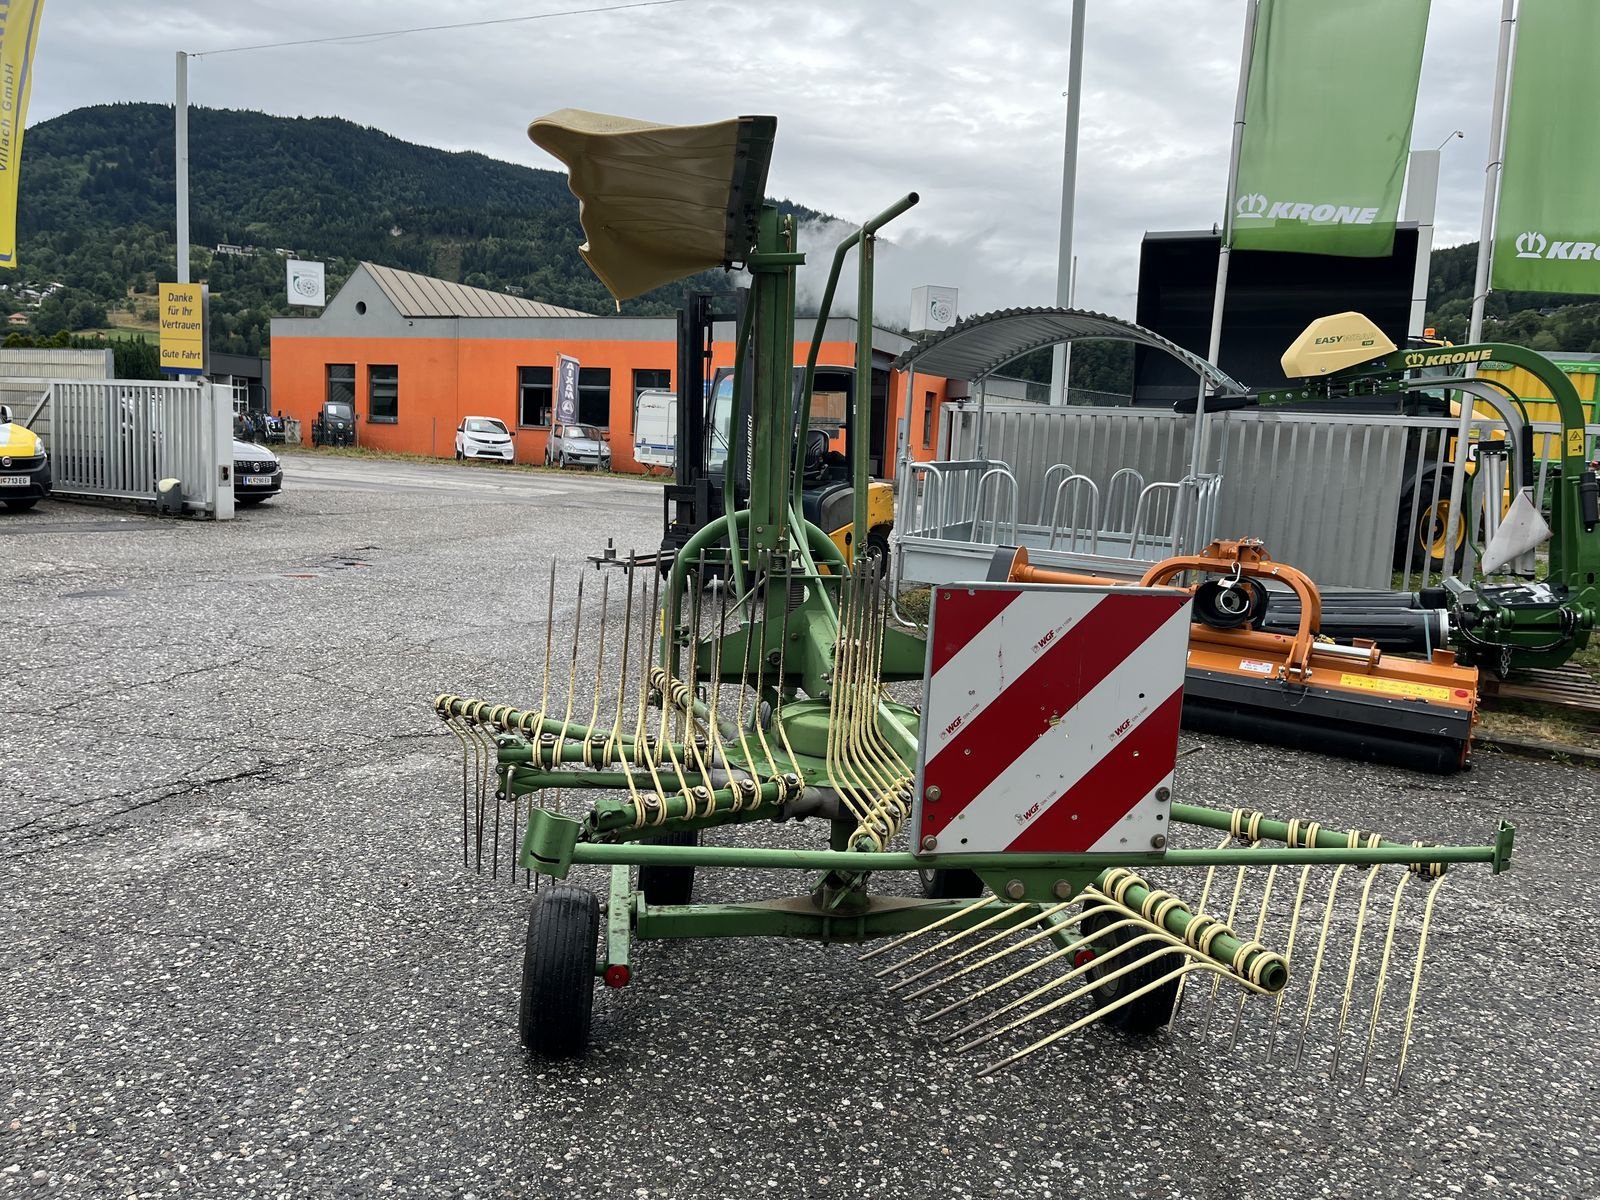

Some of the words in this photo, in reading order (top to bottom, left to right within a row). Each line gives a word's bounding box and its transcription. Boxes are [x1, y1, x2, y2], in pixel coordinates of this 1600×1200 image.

[2, 64, 14, 112] GmbH
[0, 119, 11, 172] Villach
[1266, 201, 1380, 225] KRONE
[168, 292, 193, 303] Danke
[168, 305, 180, 316] für
[182, 306, 193, 316] Ihr
[162, 319, 201, 330] Vertrauen
[162, 349, 180, 359] Gute
[181, 350, 201, 360] Fahrt
[1425, 349, 1493, 366] KRONE
[564, 362, 575, 400] AIXAM
[1037, 629, 1055, 647] WGF
[945, 715, 962, 734] WGF
[1114, 718, 1131, 736] WGF
[1023, 802, 1040, 820] WGF
